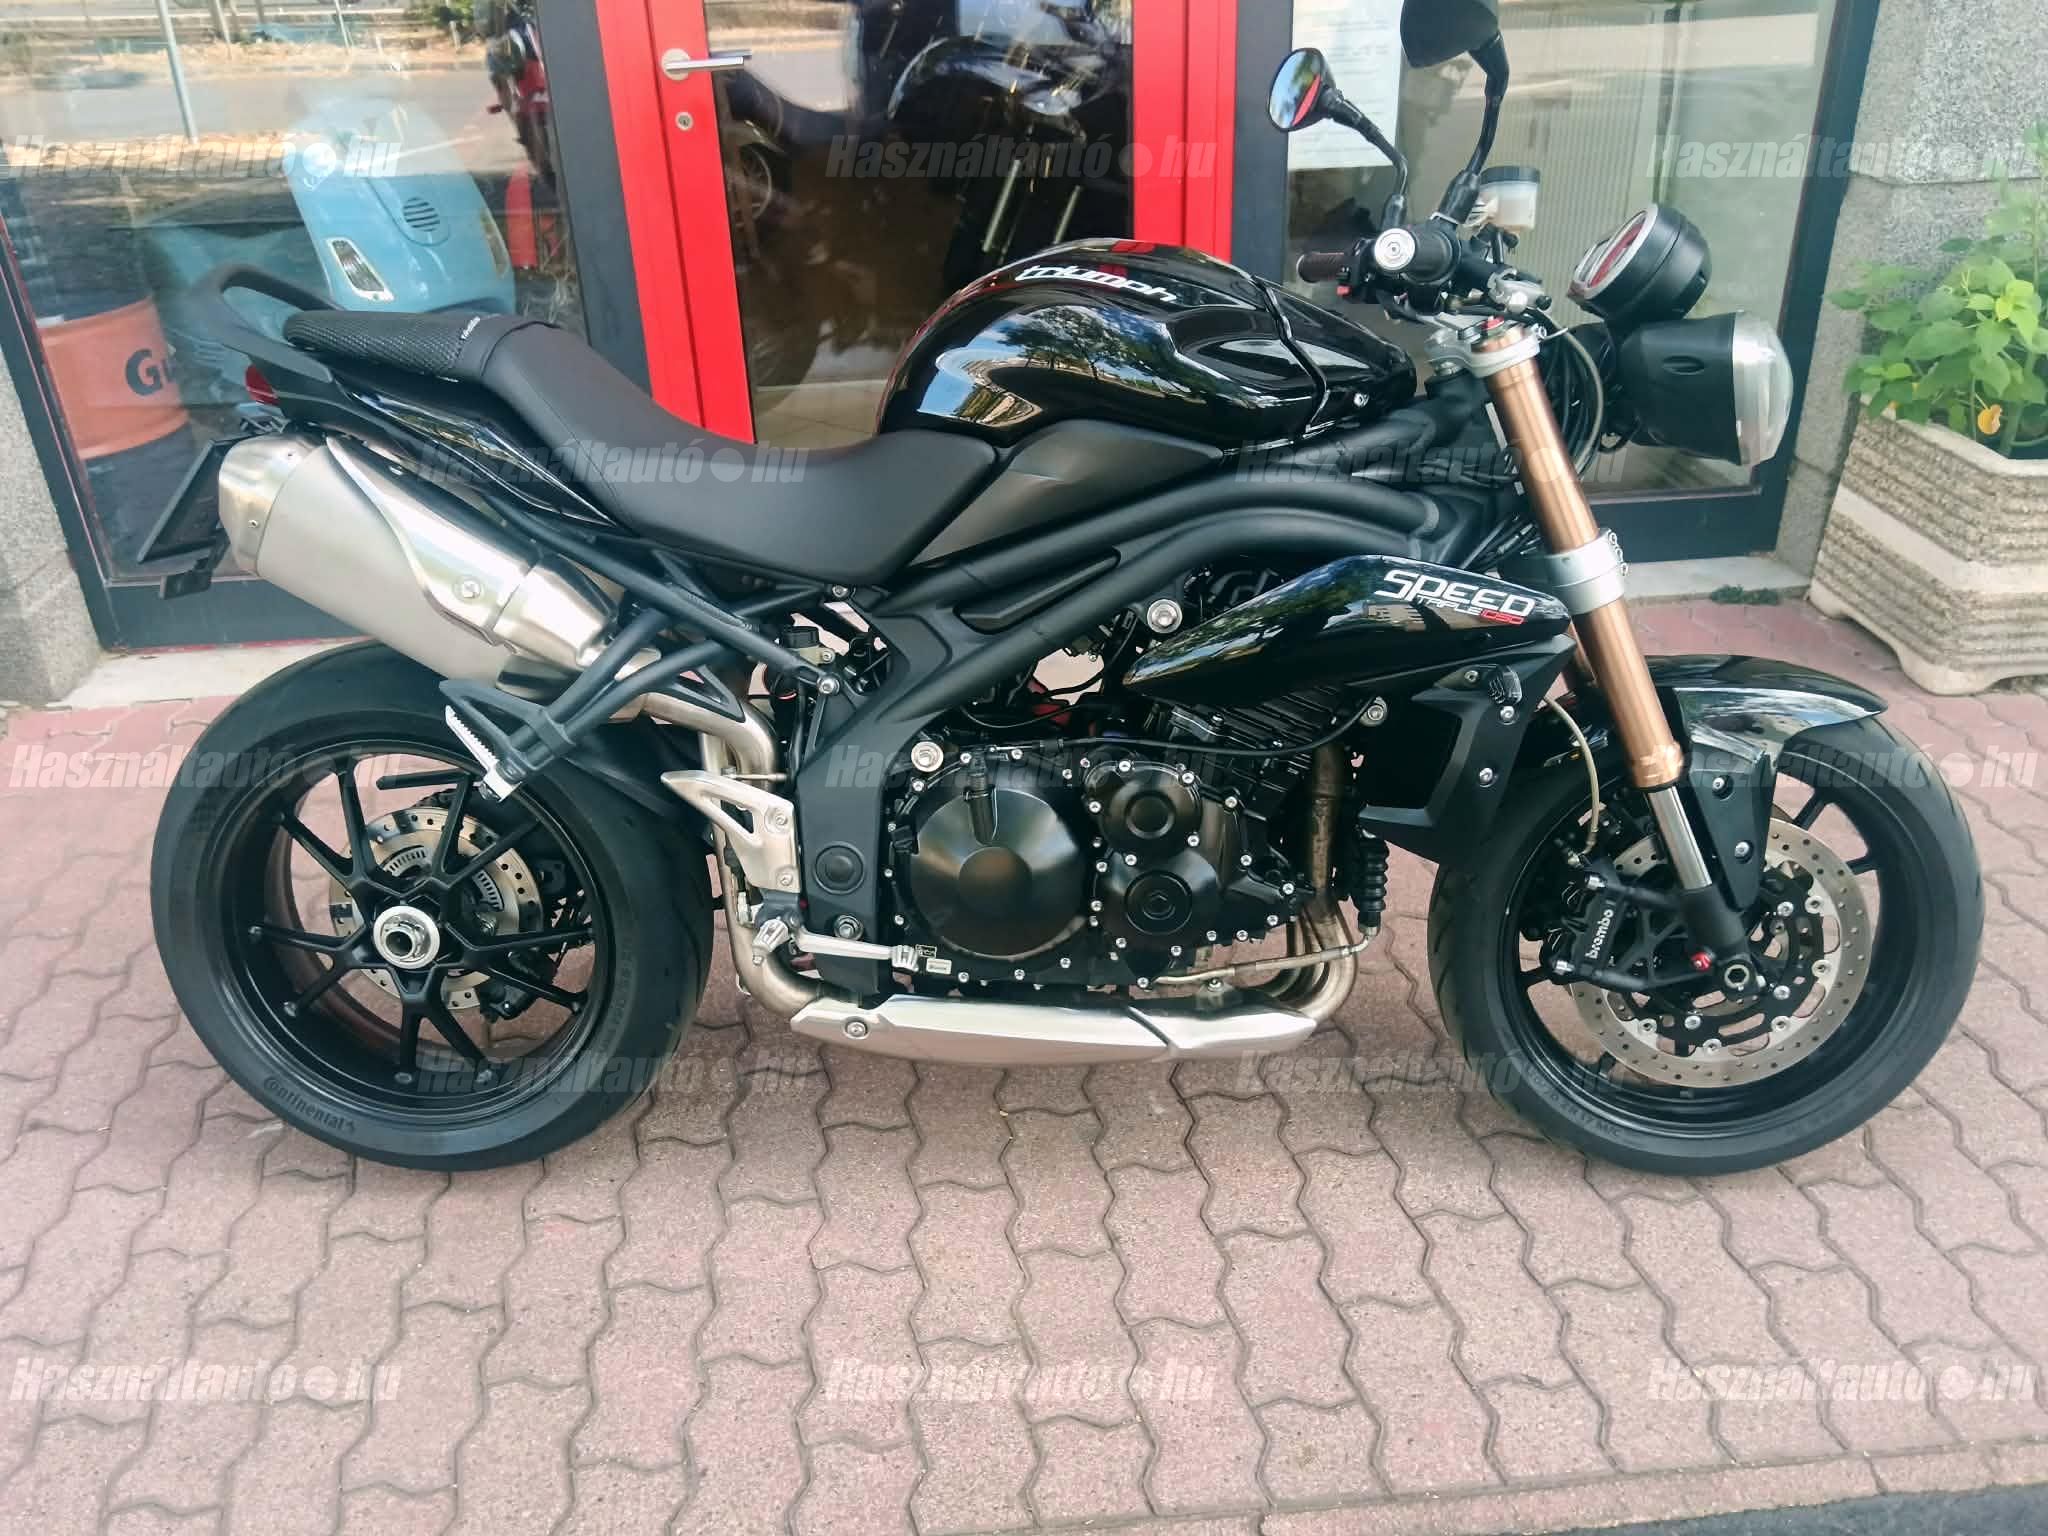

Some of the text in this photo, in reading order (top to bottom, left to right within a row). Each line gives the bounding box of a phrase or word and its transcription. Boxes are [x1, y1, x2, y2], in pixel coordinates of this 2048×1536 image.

[1374, 569, 1537, 617] SPEED
[1416, 595, 1527, 625] TRIPLE 1050
[1585, 909, 1614, 959] brembo
[264, 1075, 346, 1131] Continental
